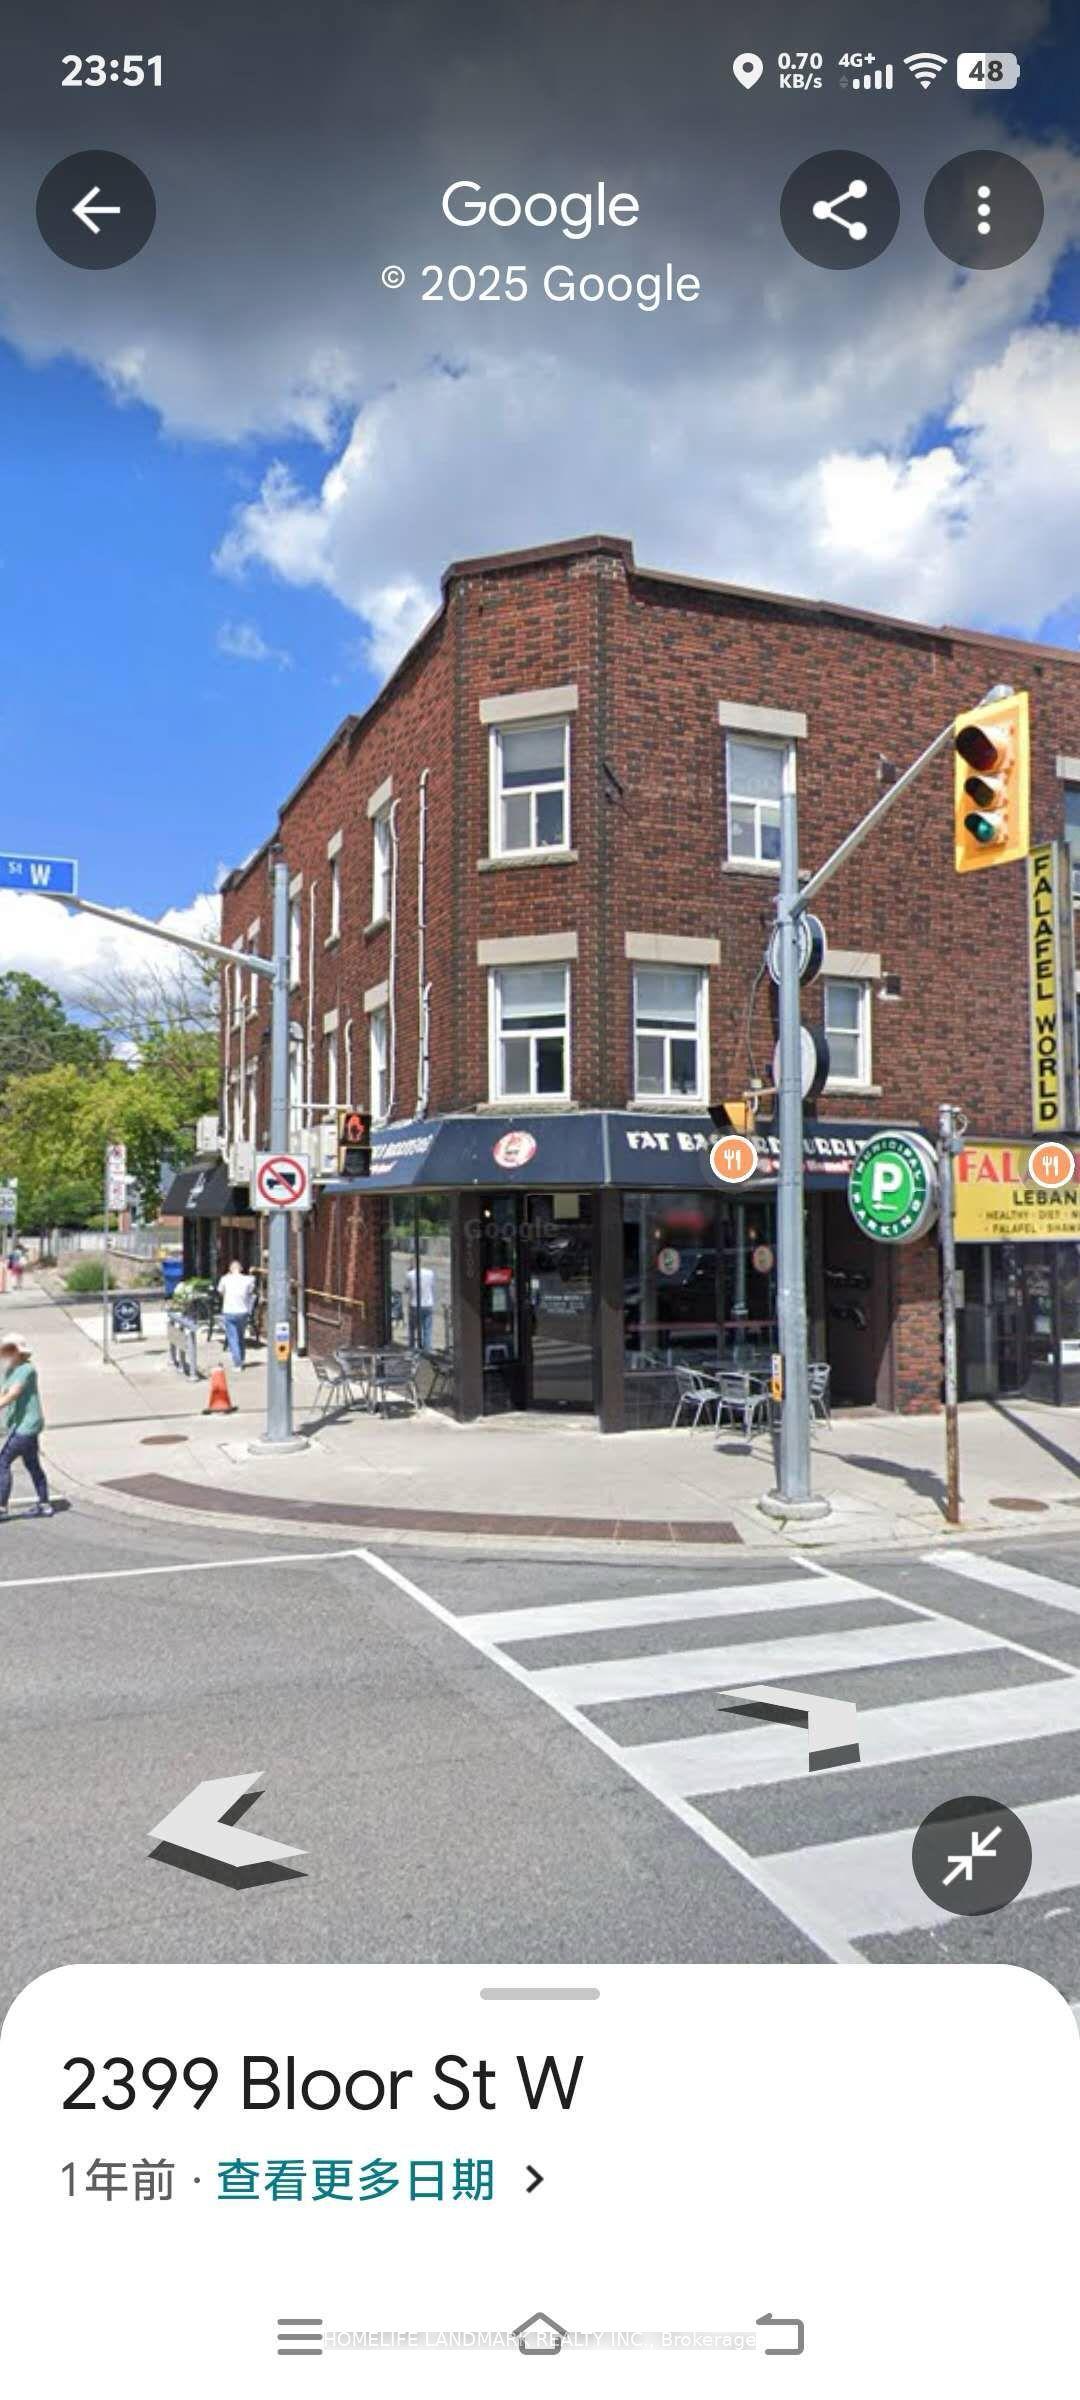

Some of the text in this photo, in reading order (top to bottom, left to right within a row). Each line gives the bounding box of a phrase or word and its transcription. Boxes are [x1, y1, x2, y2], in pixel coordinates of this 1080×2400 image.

[30, 863, 51, 888] W
[1033, 856, 1058, 1122] FALAFEL WORLD
[625, 1130, 670, 1151] FAT
[872, 1161, 904, 1202] P
[853, 1191, 922, 1236] PARKING
